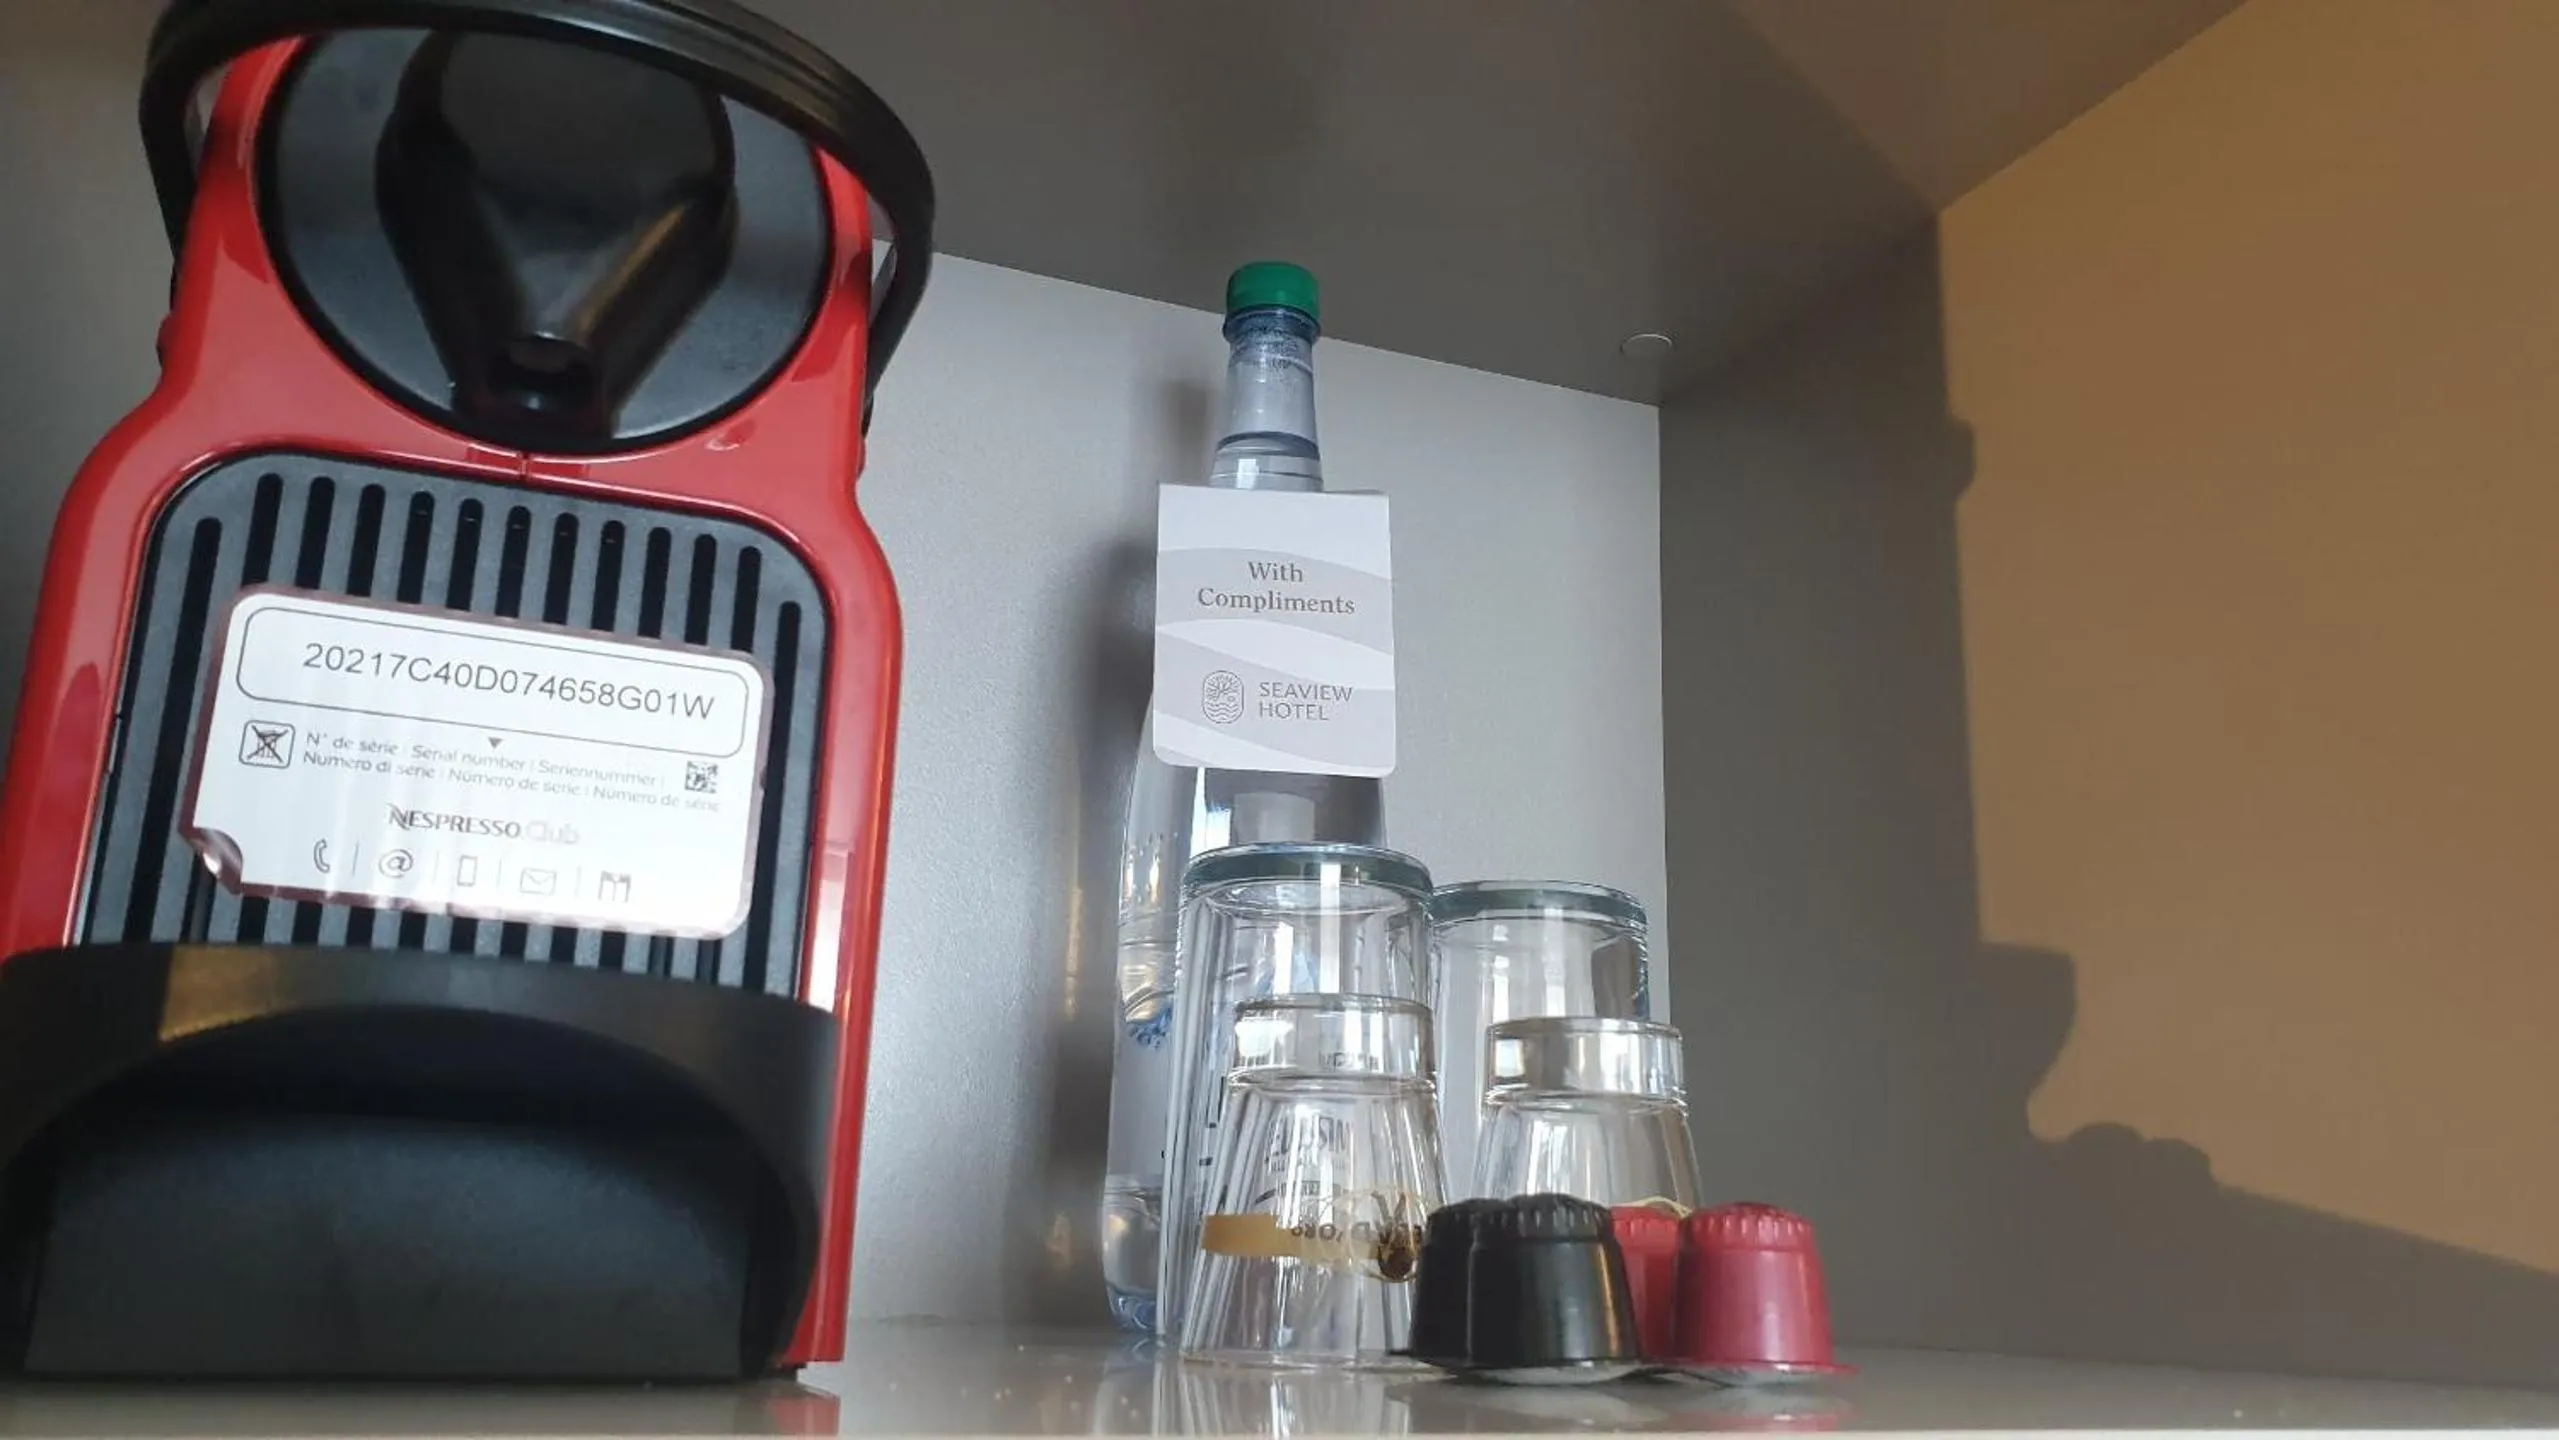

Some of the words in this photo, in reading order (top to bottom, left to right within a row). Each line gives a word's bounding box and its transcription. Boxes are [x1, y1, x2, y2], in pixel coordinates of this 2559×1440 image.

[1248, 560, 1303, 582] With
[1198, 588, 1355, 615] Compliments
[303, 641, 716, 720] 20217C40D074658G01W
[1259, 682, 1353, 702] SEAVIEW
[1259, 702, 1330, 721] HOTEL
[332, 737, 354, 750] de
[411, 744, 458, 762] Serial
[461, 753, 525, 772] number
[375, 758, 392, 774] di
[518, 776, 540, 791] de
[386, 802, 522, 840] NESPRESSO
